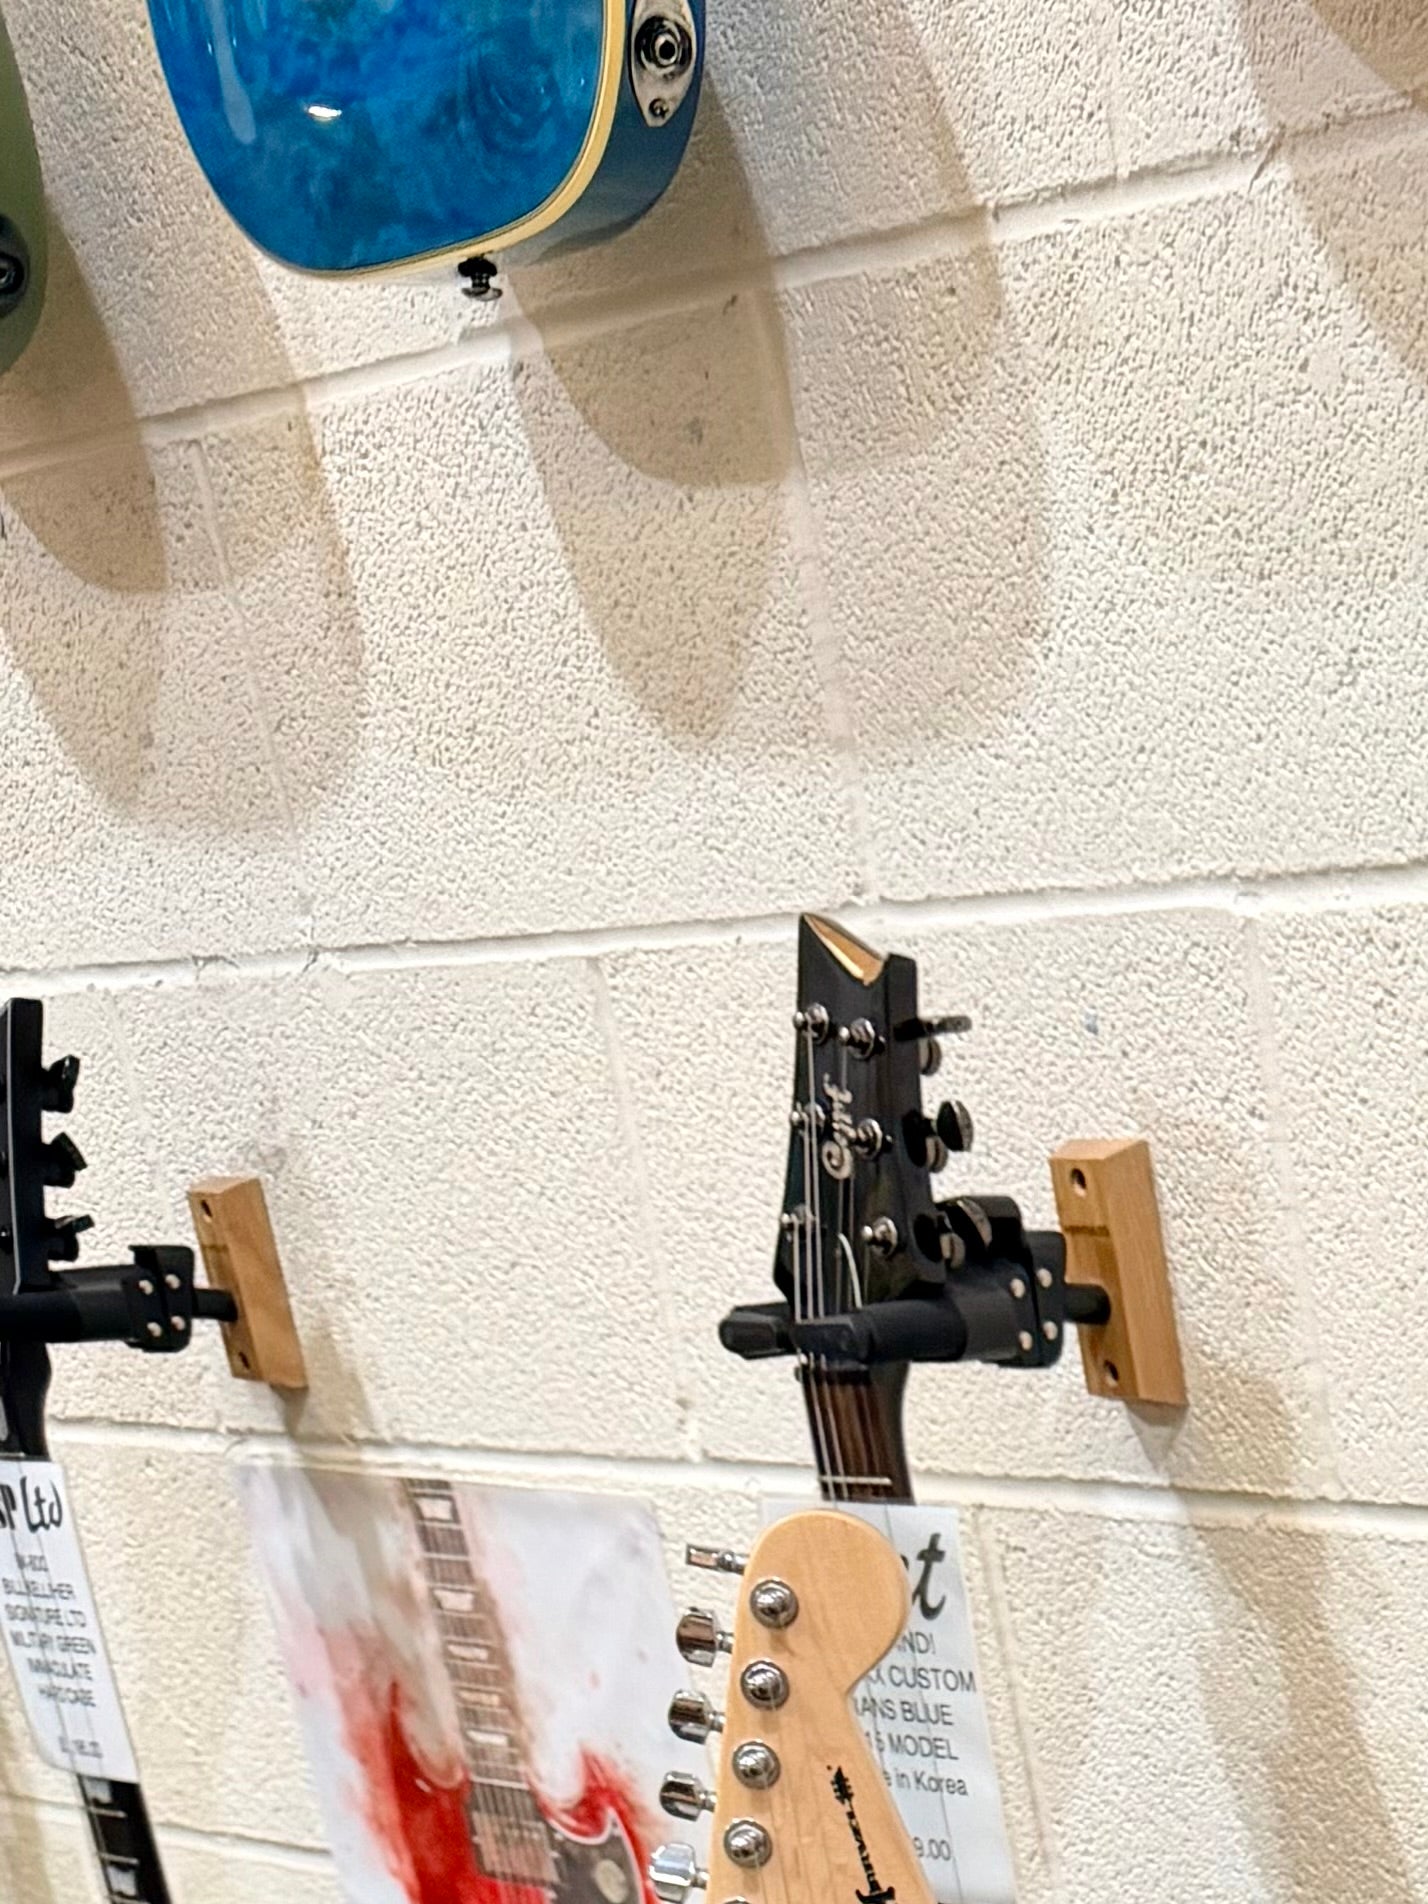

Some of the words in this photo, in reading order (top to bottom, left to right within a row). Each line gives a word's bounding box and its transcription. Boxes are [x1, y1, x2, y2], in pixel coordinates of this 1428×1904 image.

[20, 1475, 63, 1534] Ltd
[888, 1665, 977, 1693] CUSTOM
[899, 1700, 955, 1727] BLUE
[888, 1732, 960, 1761] MODEL
[894, 1767, 911, 1790] in
[913, 1769, 969, 1797] Korea
[912, 1836, 952, 1862] 9.00
